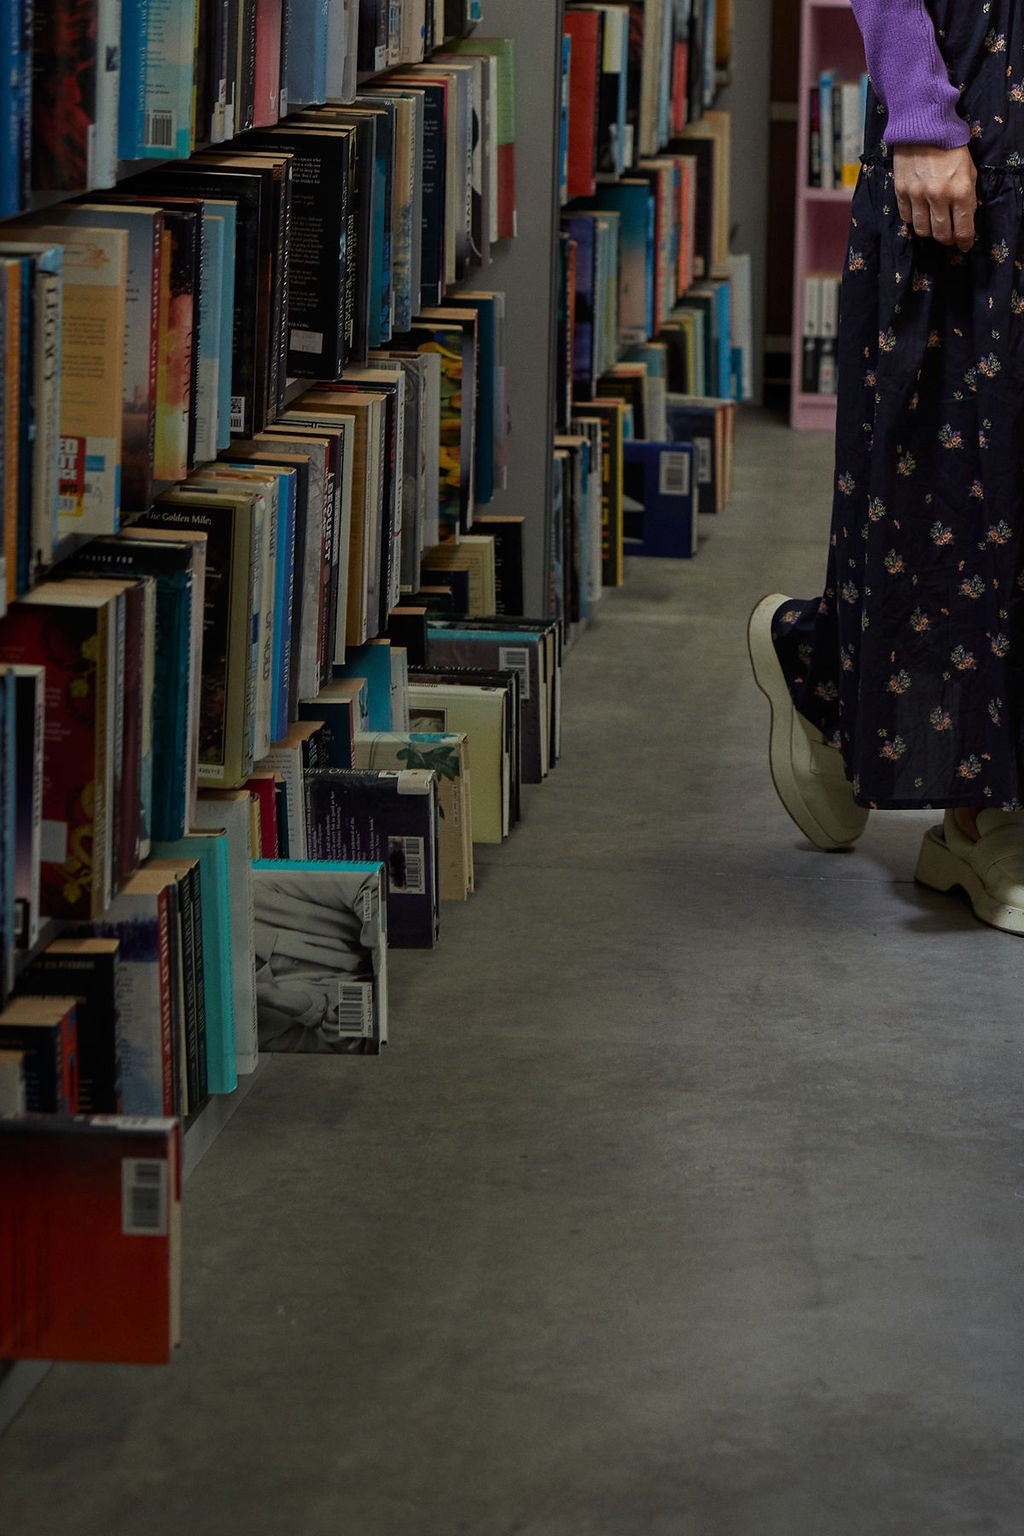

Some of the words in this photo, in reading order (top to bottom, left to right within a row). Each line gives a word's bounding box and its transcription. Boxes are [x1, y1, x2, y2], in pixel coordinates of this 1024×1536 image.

[282, 240, 290, 306] CRYSTAL
[44, 287, 57, 383] LEGACY
[182, 329, 193, 423] GRACE
[146, 510, 160, 521] The
[162, 512, 190, 522] Golden
[191, 515, 212, 525] Mile:
[324, 483, 333, 561] BEQUEST
[160, 910, 169, 983] CHILD
[162, 985, 172, 1056] THIEF
